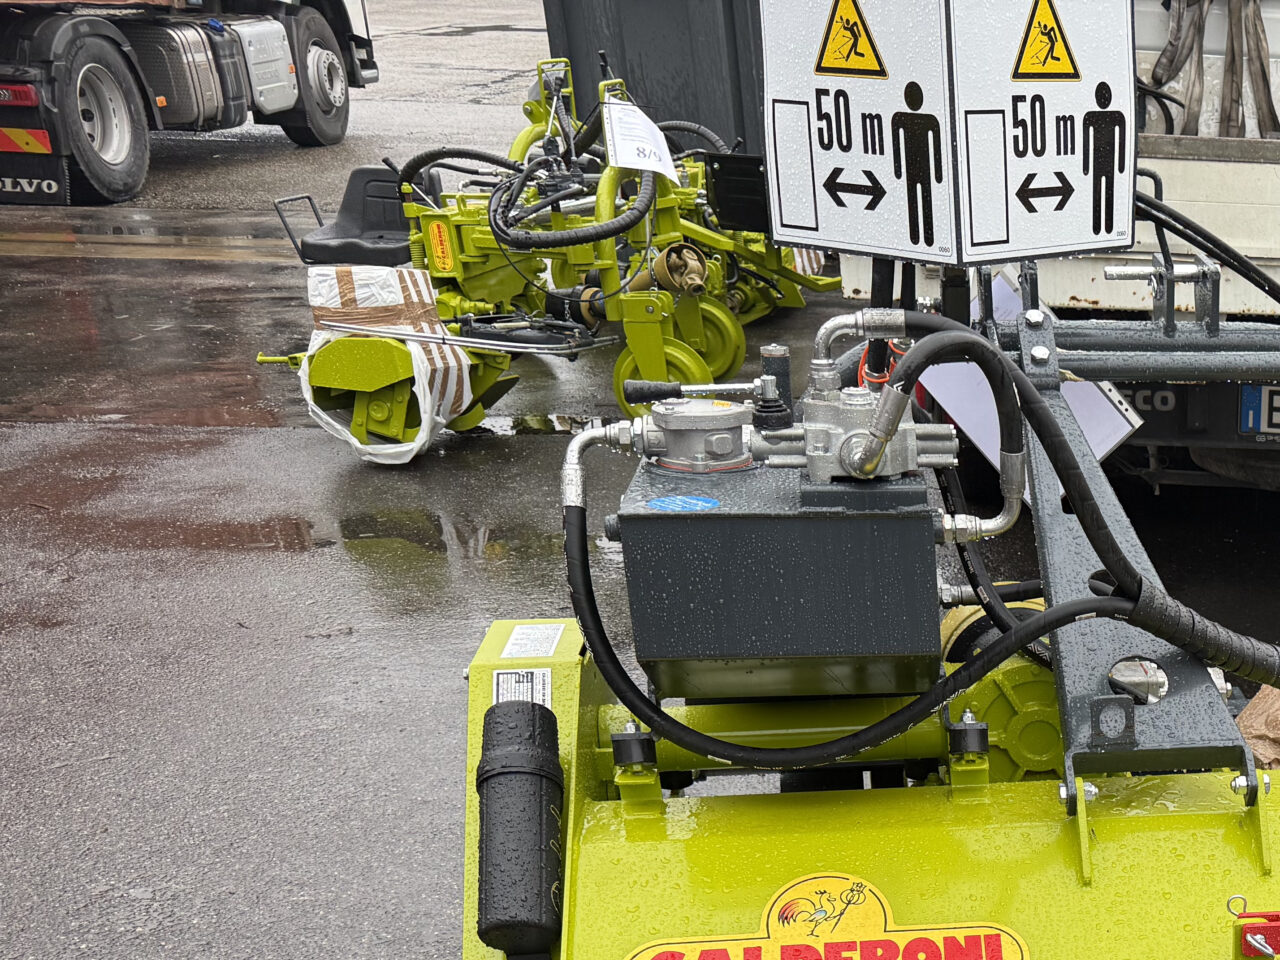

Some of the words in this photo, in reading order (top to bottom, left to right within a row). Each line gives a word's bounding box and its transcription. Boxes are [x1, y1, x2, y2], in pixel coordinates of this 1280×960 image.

[815, 87, 852, 153] 50
[860, 112, 885, 156] m
[1011, 94, 1047, 158] 50
[1055, 114, 1076, 156] m
[0, 177, 59, 194] LVO
